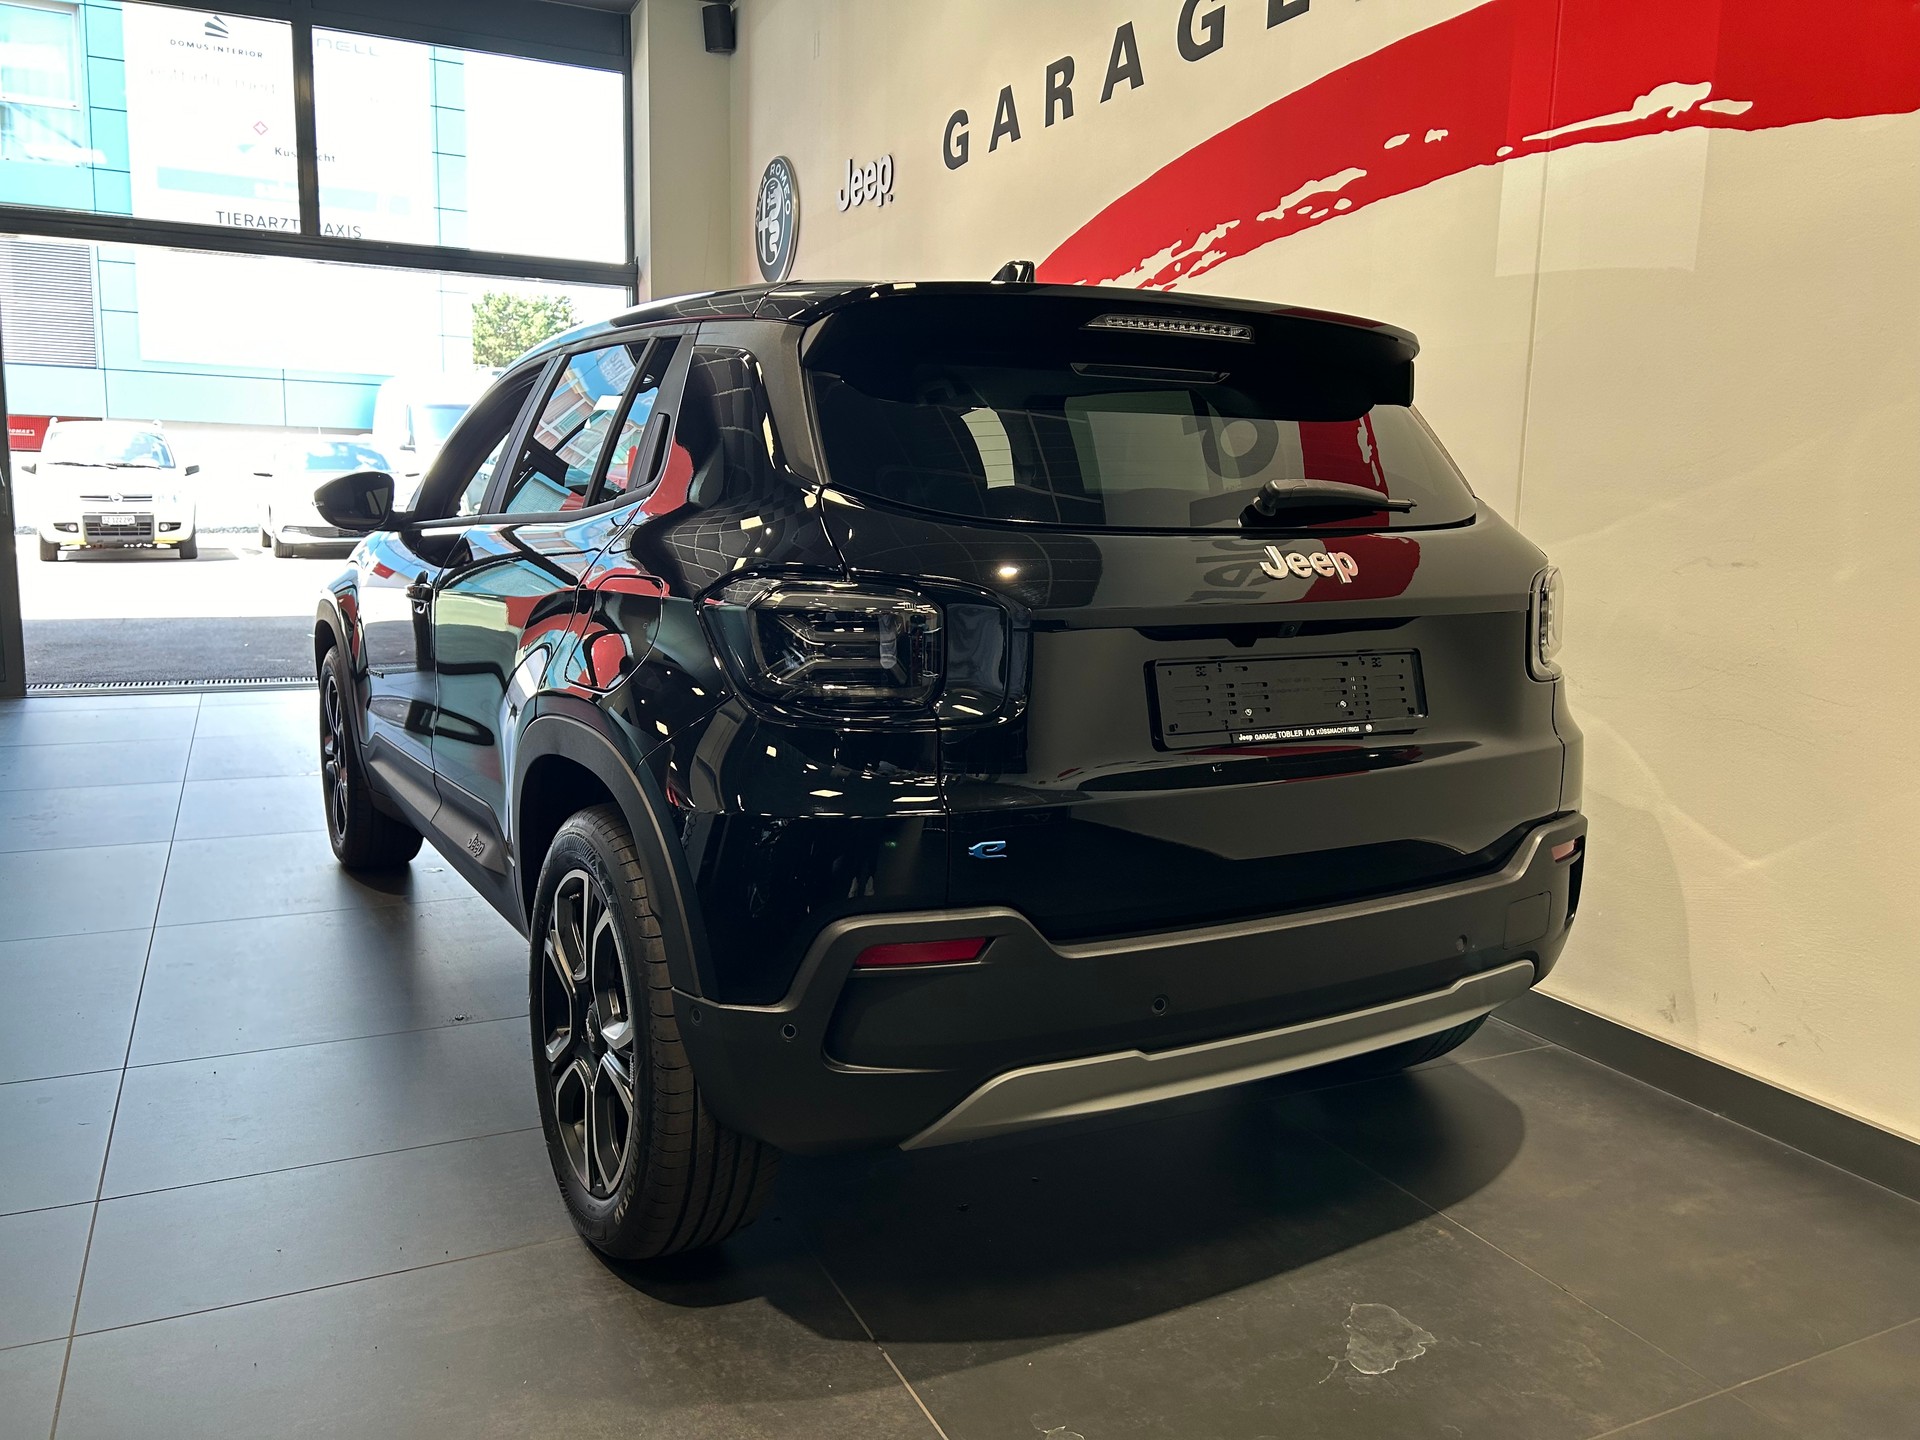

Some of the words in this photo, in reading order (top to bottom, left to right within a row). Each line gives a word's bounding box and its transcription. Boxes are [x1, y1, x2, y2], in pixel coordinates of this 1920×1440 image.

[169, 39, 209, 51] DOMUS
[213, 45, 263, 58] INTERIOR
[943, 0, 1310, 170] GARAG
[769, 163, 791, 215] ROMEO
[836, 154, 894, 212] Jeep
[1260, 545, 1359, 584] Jeep
[1238, 733, 1253, 742] Jeep
[1254, 732, 1278, 741] GARAGE
[1277, 729, 1304, 739] TOBLER
[1305, 729, 1315, 737] AG
